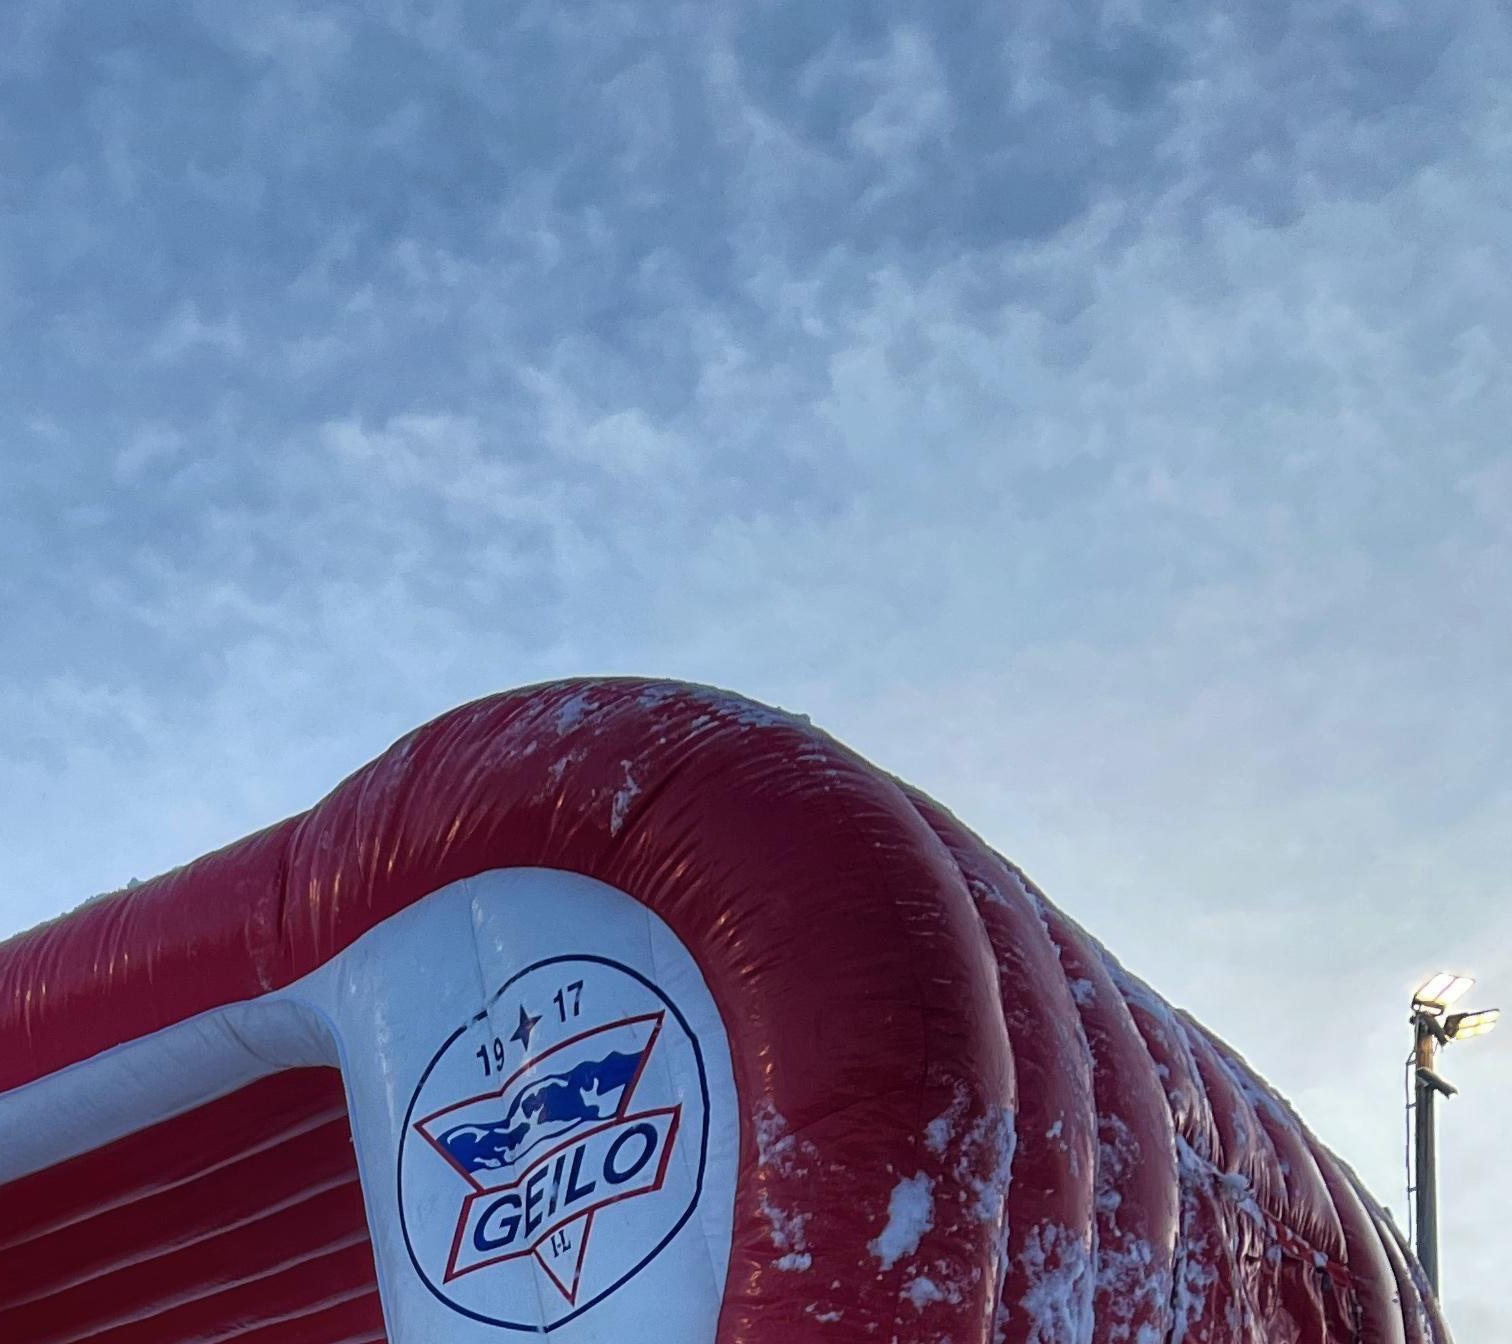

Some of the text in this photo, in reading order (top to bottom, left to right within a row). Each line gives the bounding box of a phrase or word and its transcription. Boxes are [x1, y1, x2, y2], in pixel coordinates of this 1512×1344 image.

[476, 980, 585, 1076] 19 17
[473, 1122, 659, 1252] GEILO
